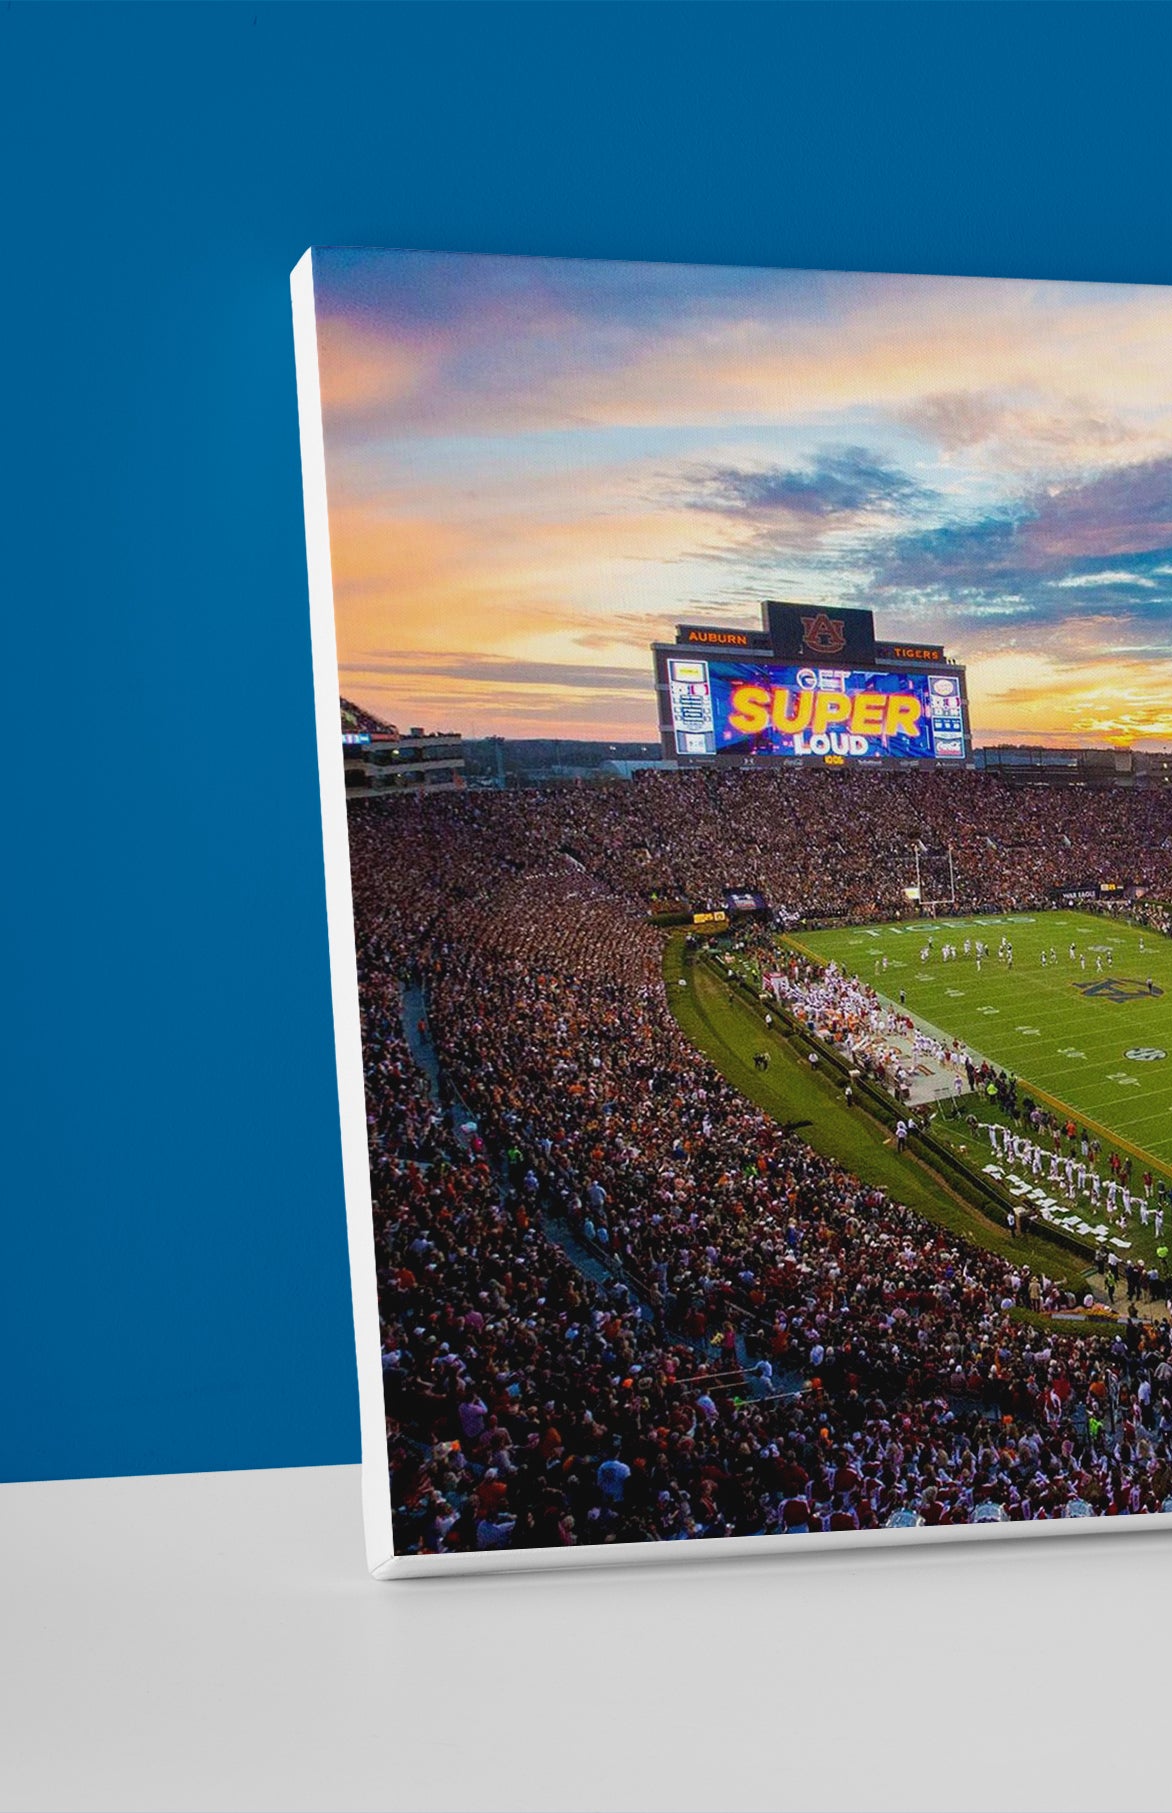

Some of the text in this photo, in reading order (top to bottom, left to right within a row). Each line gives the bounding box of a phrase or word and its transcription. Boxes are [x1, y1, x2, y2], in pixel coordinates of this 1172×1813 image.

[689, 631, 747, 645] AUBURN
[894, 647, 939, 660] TIGERS
[728, 686, 921, 736] SUPER
[793, 732, 869, 756] LOUD
